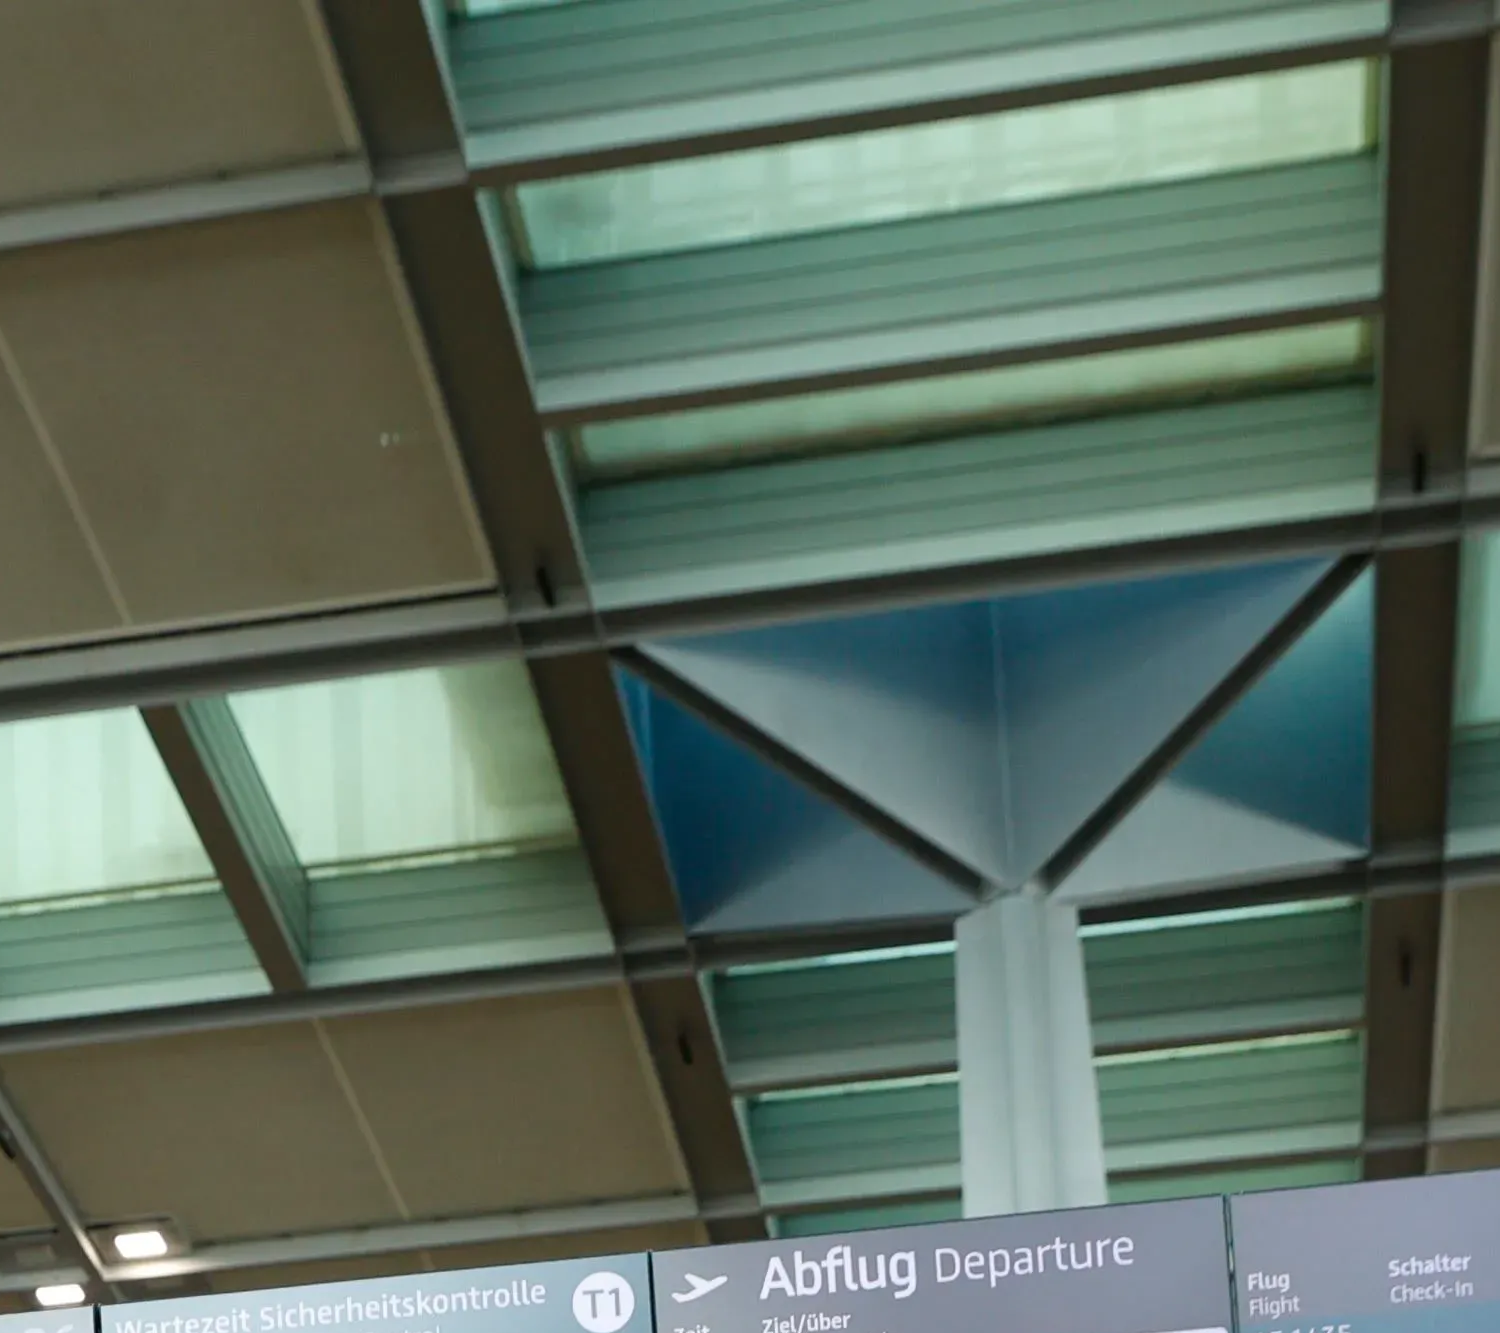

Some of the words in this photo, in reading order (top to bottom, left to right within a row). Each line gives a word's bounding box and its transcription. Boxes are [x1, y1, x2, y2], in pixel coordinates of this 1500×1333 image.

[759, 1245, 917, 1300] Abflug
[934, 1236, 1134, 1288] Departure
[1388, 1253, 1472, 1278] Schalter
[1247, 1271, 1291, 1294] Flug
[582, 1287, 623, 1317] T1
